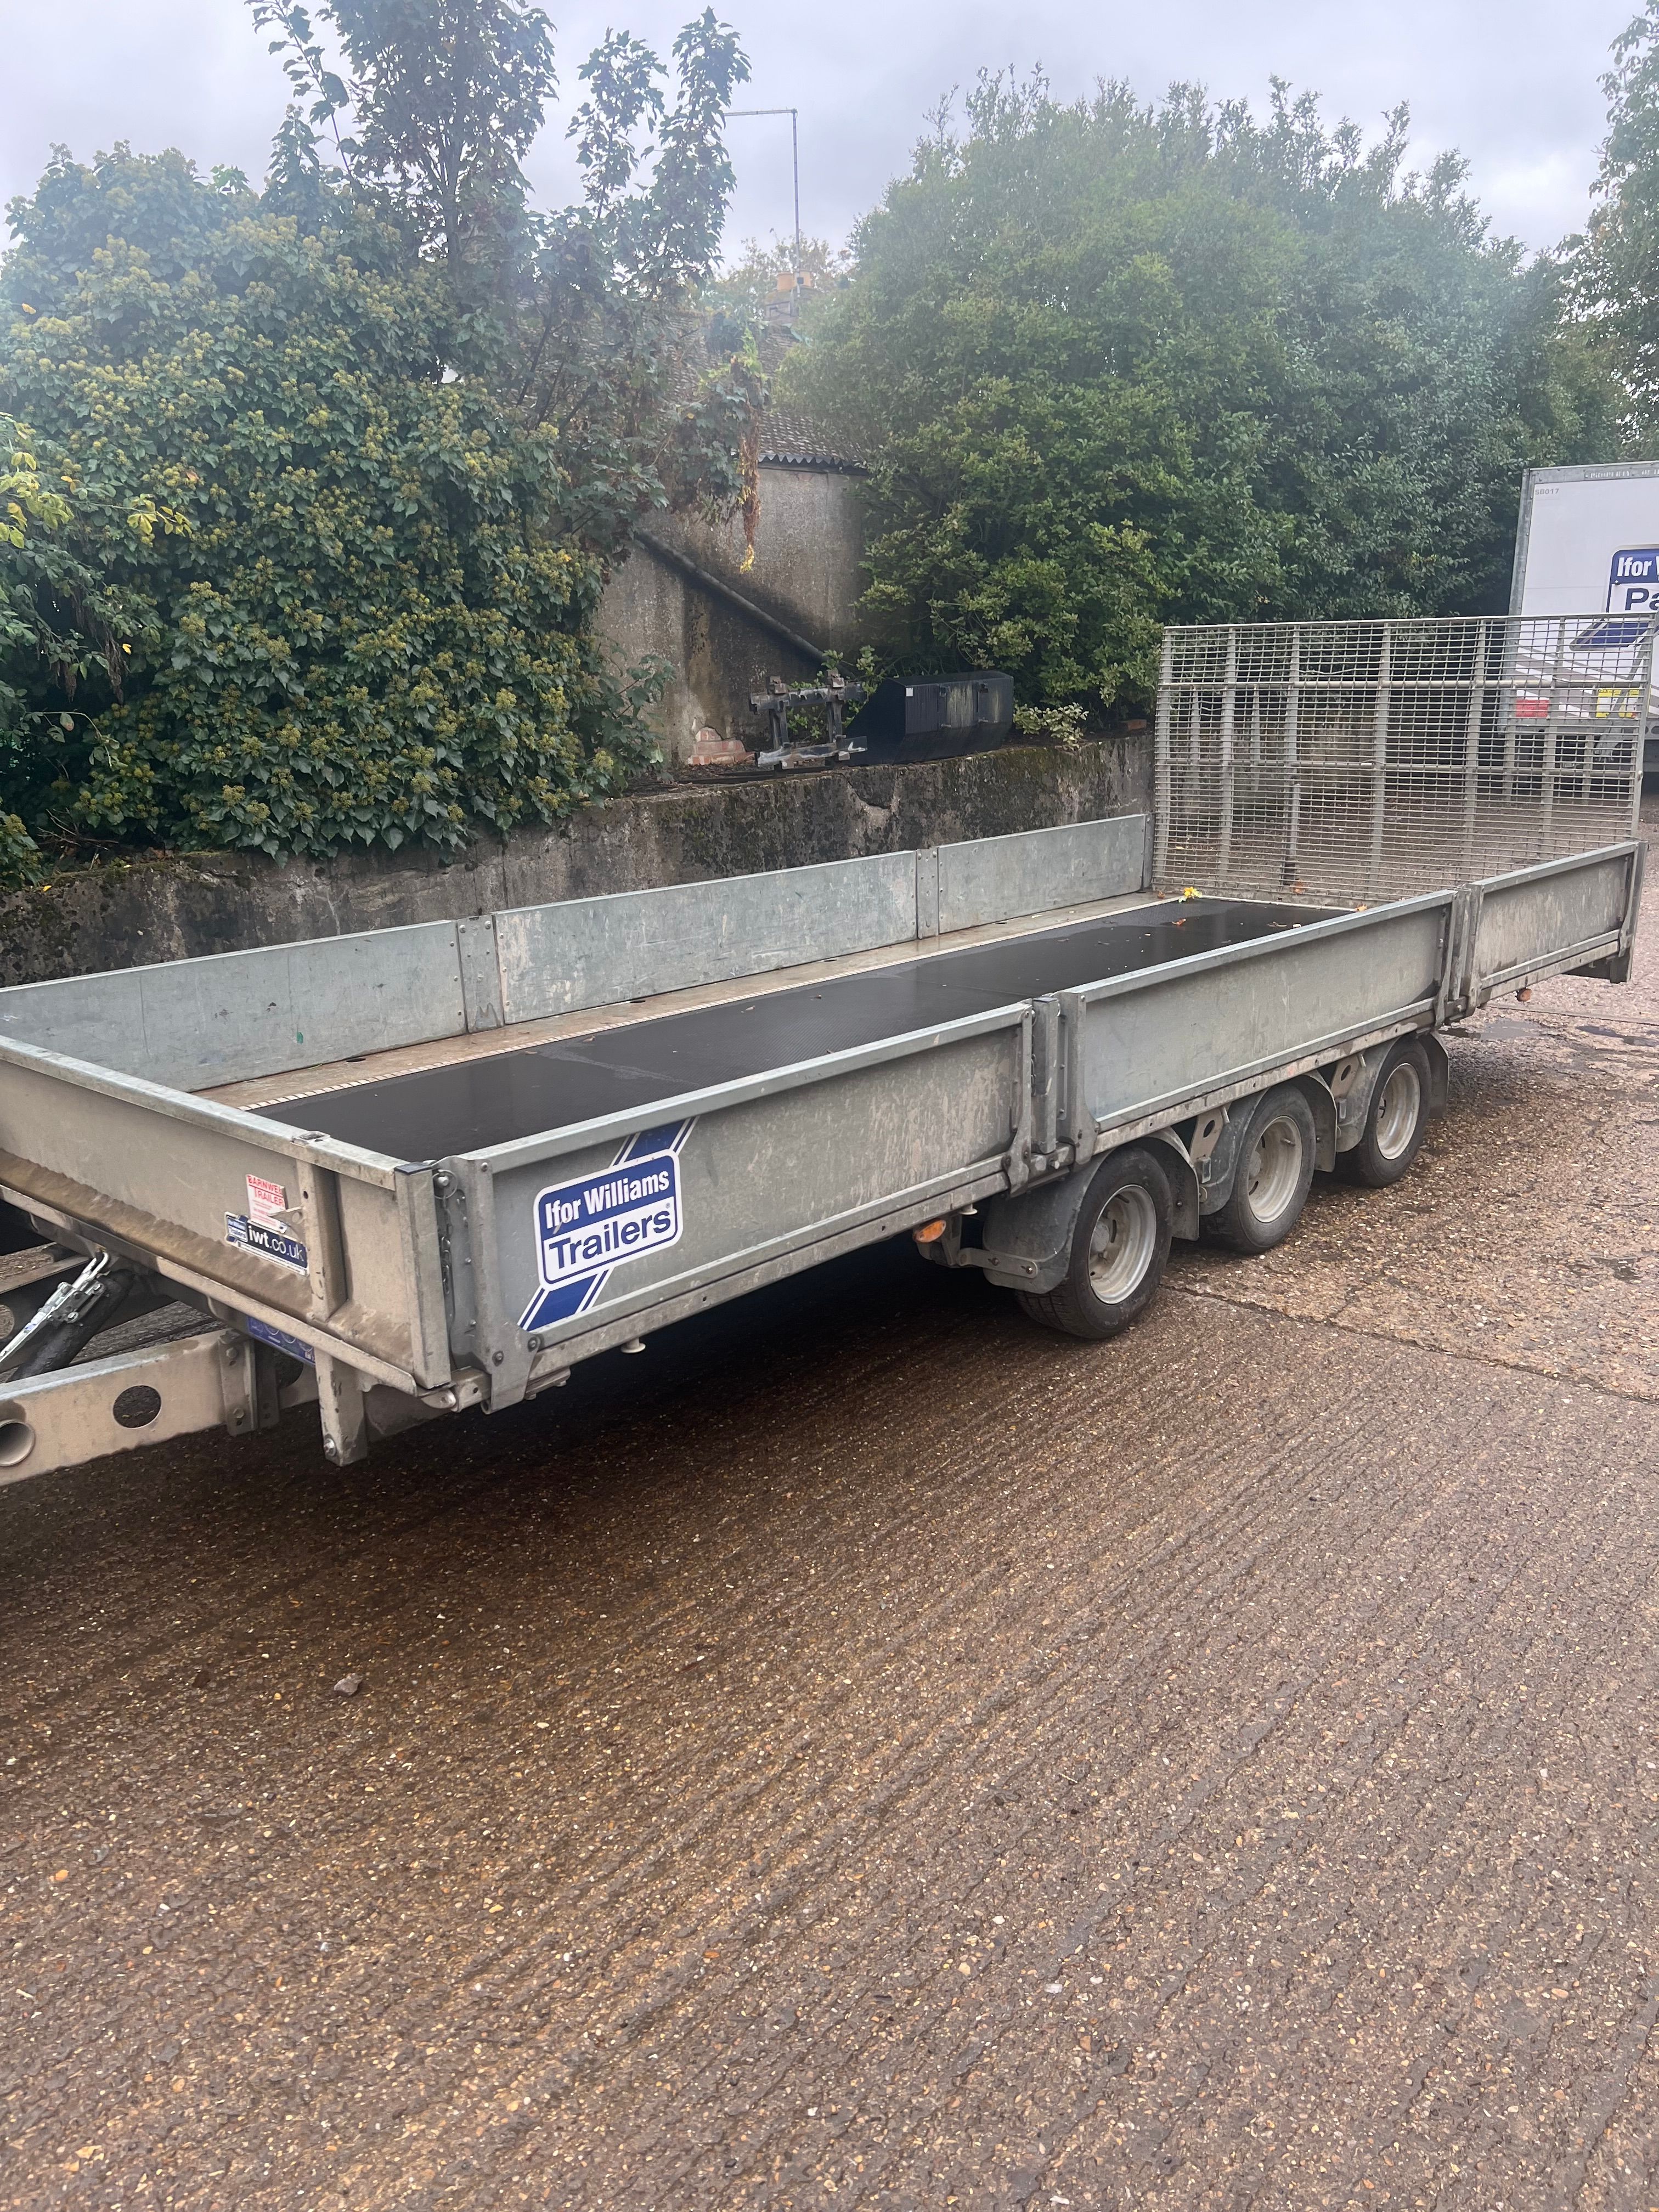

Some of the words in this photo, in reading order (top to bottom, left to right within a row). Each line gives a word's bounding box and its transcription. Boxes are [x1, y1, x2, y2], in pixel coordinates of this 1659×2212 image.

[1617, 556, 1652, 577] Ifor
[545, 1198, 582, 1229] Ifor
[583, 1170, 670, 1215] Williams
[248, 1225, 304, 1262] iwt.co.uk
[549, 1210, 671, 1269] Trailers
